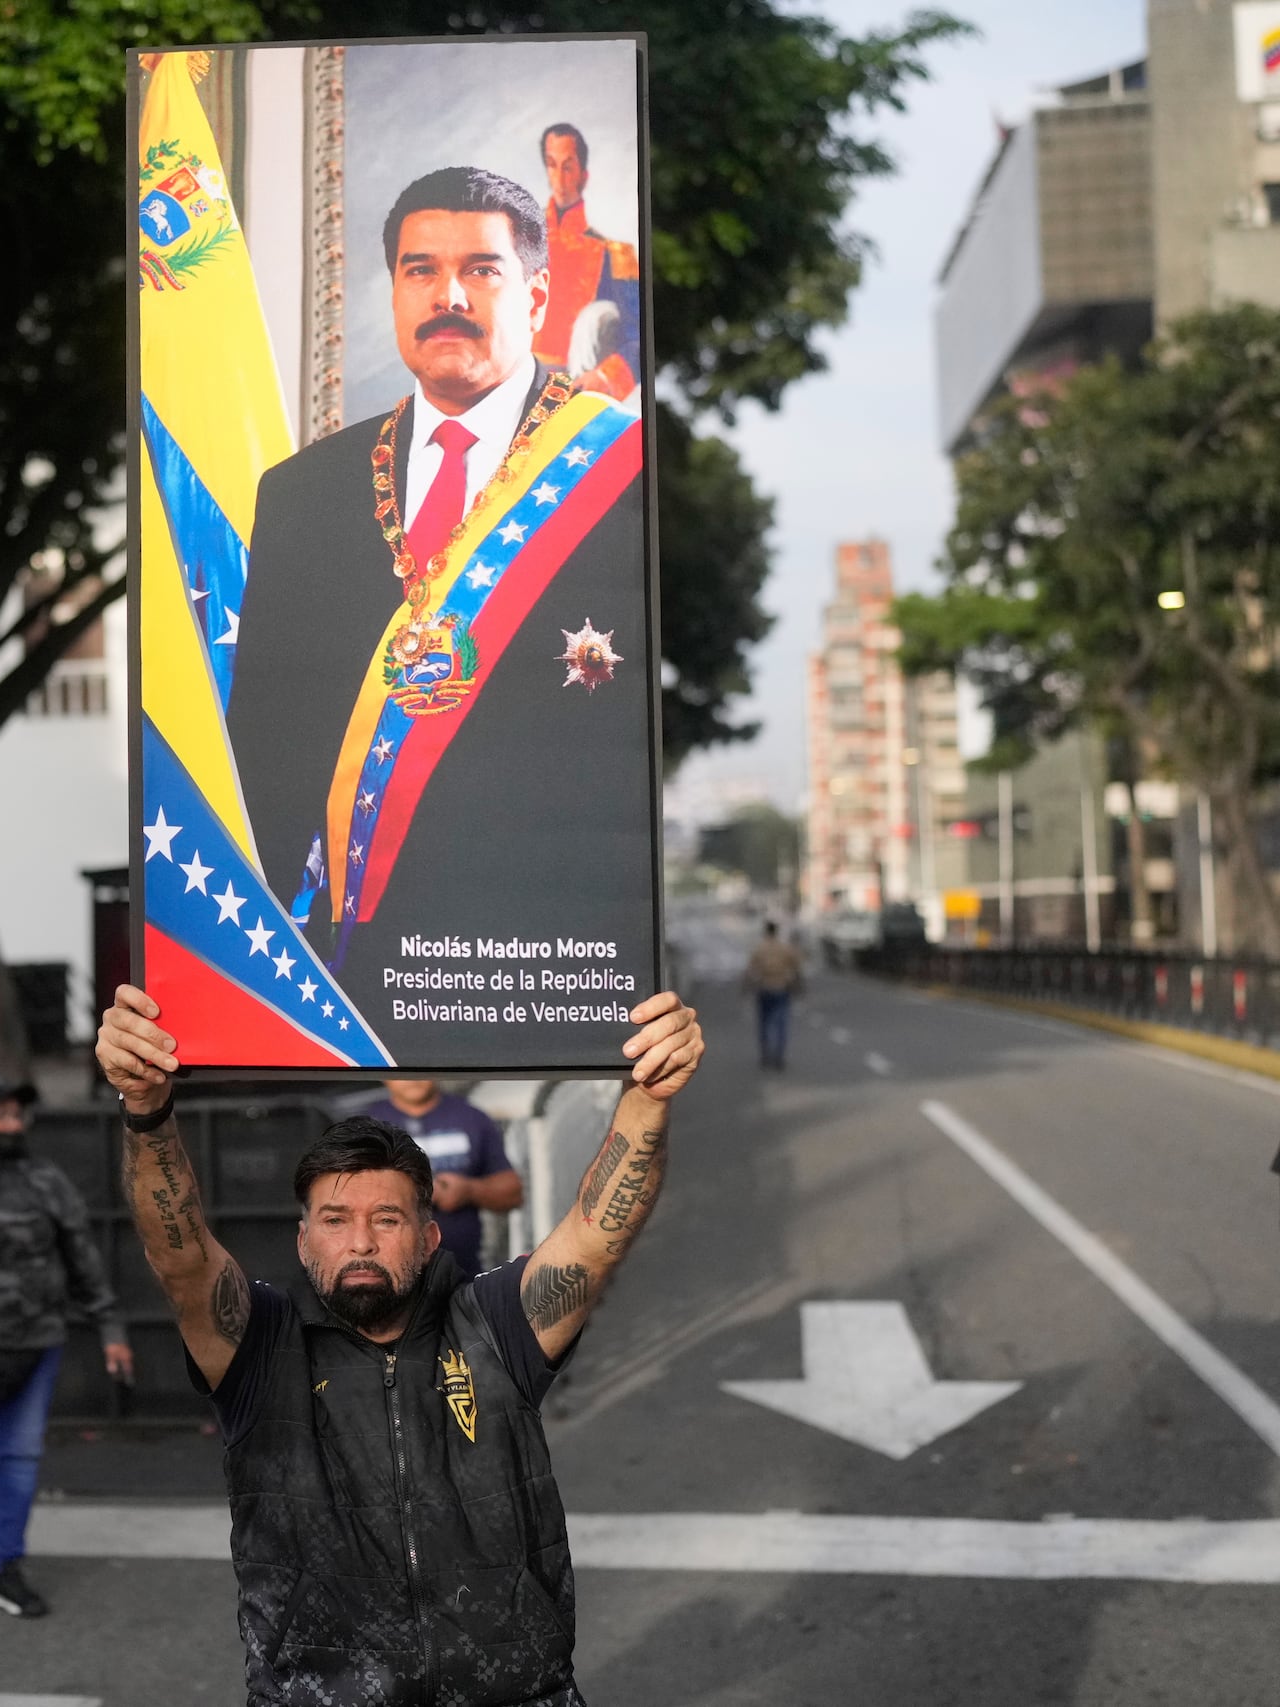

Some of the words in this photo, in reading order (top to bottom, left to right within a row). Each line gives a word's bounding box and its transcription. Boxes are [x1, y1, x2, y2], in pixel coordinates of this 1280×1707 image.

[401, 934, 471, 958] Nicolás
[476, 937, 551, 959] Maduro
[557, 938, 617, 959] Moros
[383, 967, 485, 990] Presidente
[490, 969, 514, 990] de
[519, 969, 535, 991] la
[541, 968, 635, 994] República
[392, 999, 498, 1022] Bolivariana
[502, 1001, 527, 1022] de
[531, 1001, 630, 1023] Venezuela
